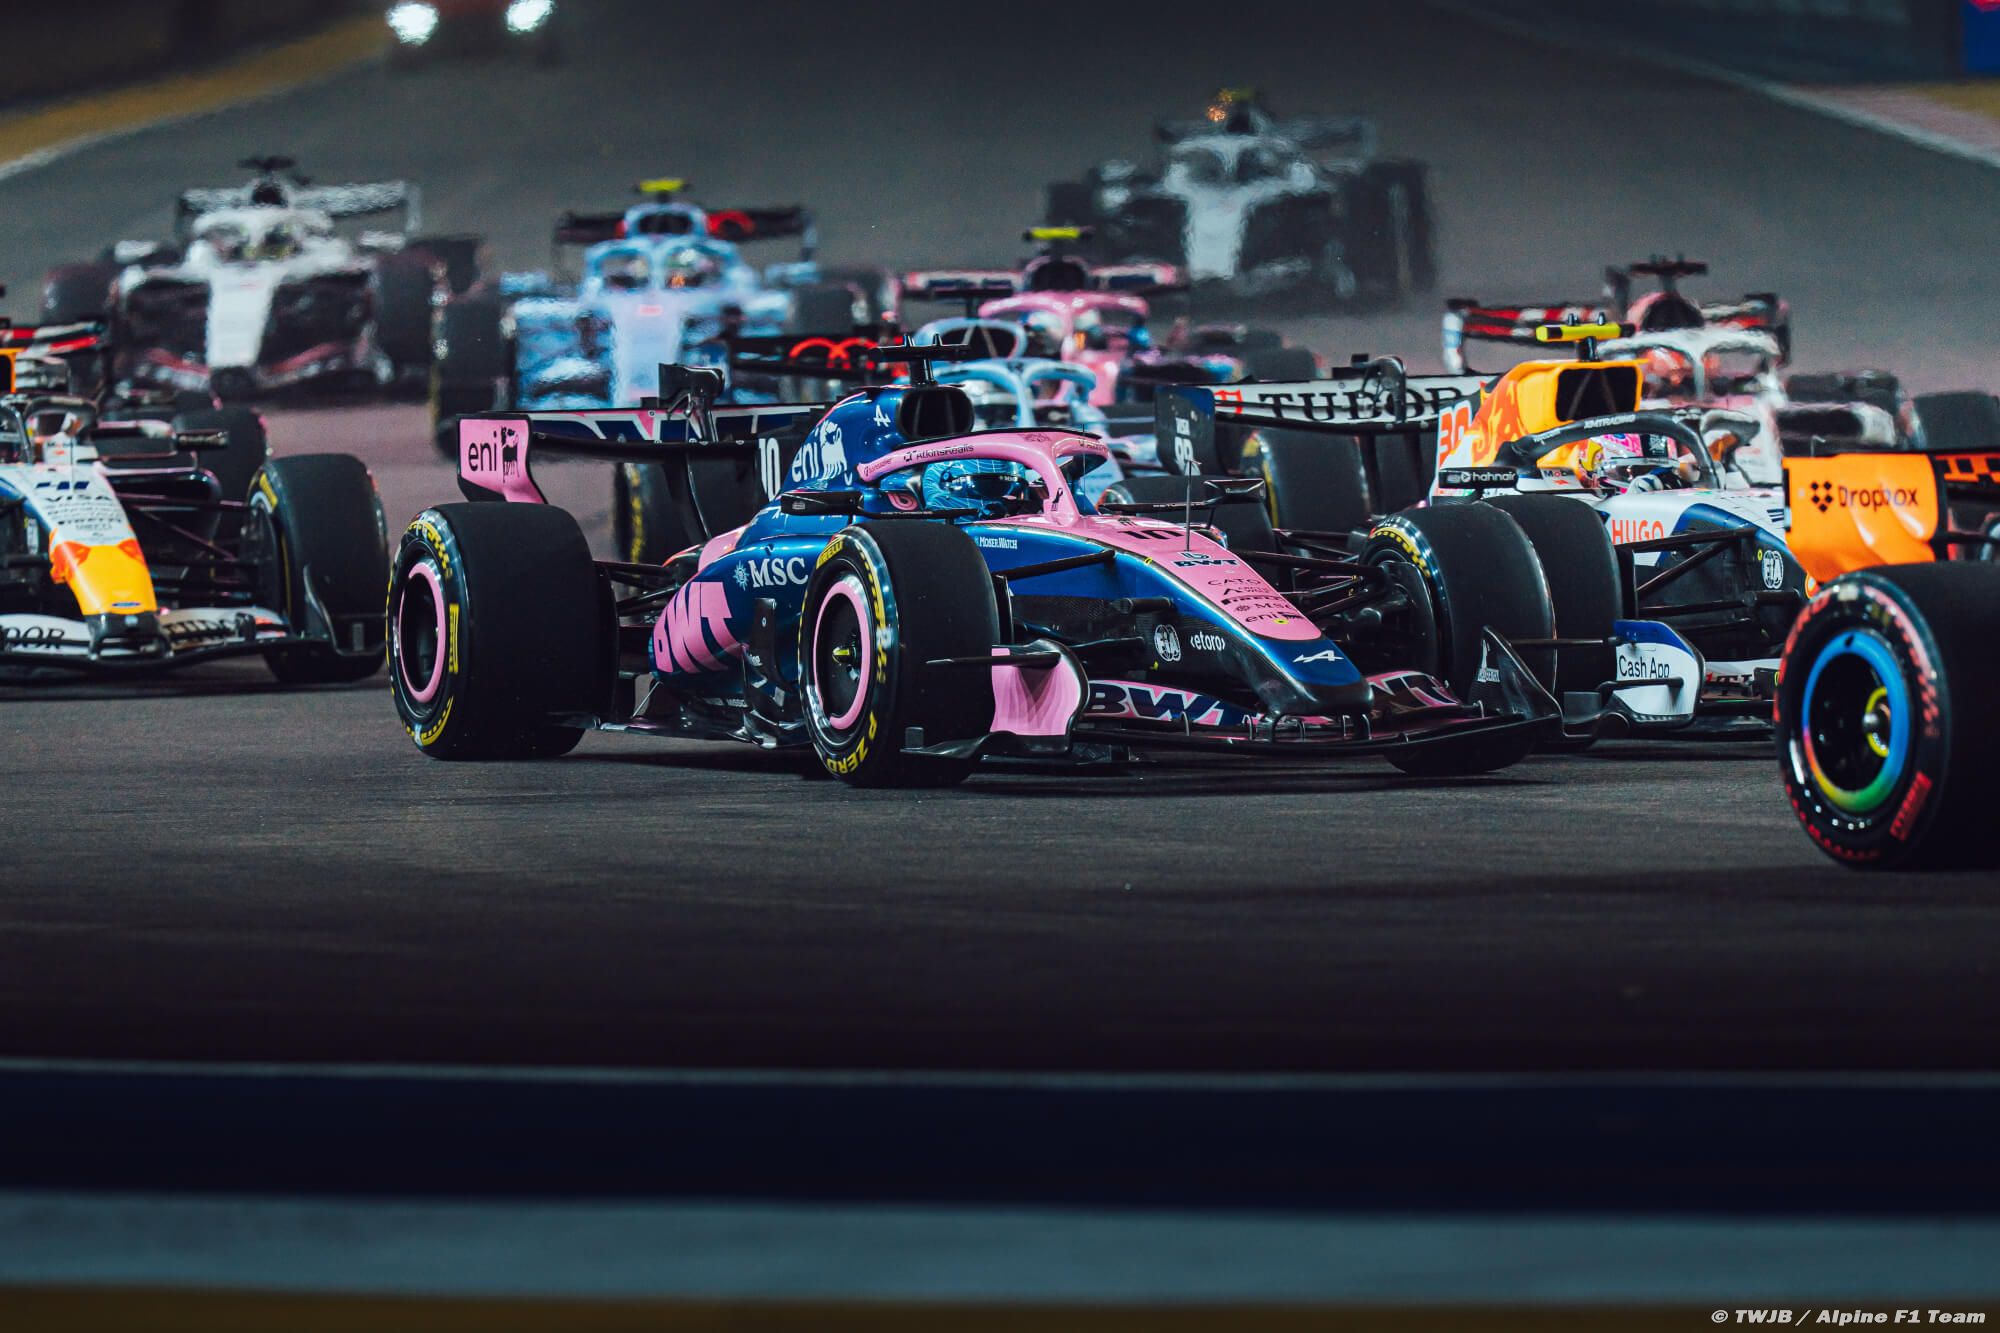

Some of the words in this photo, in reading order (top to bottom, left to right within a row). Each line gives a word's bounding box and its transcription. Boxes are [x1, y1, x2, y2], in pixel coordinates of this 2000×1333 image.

[468, 430, 497, 471] eni
[791, 426, 820, 483] eni
[758, 437, 781, 502] 10
[1472, 471, 1516, 482] hahnair
[1838, 485, 1919, 512] Dropbox
[1117, 529, 1185, 540] 10
[1612, 519, 1665, 545] HUGO
[747, 556, 809, 588] MSC
[1172, 558, 1239, 568] BWT
[1245, 611, 1279, 623] eni
[1618, 655, 1648, 680] Cash
